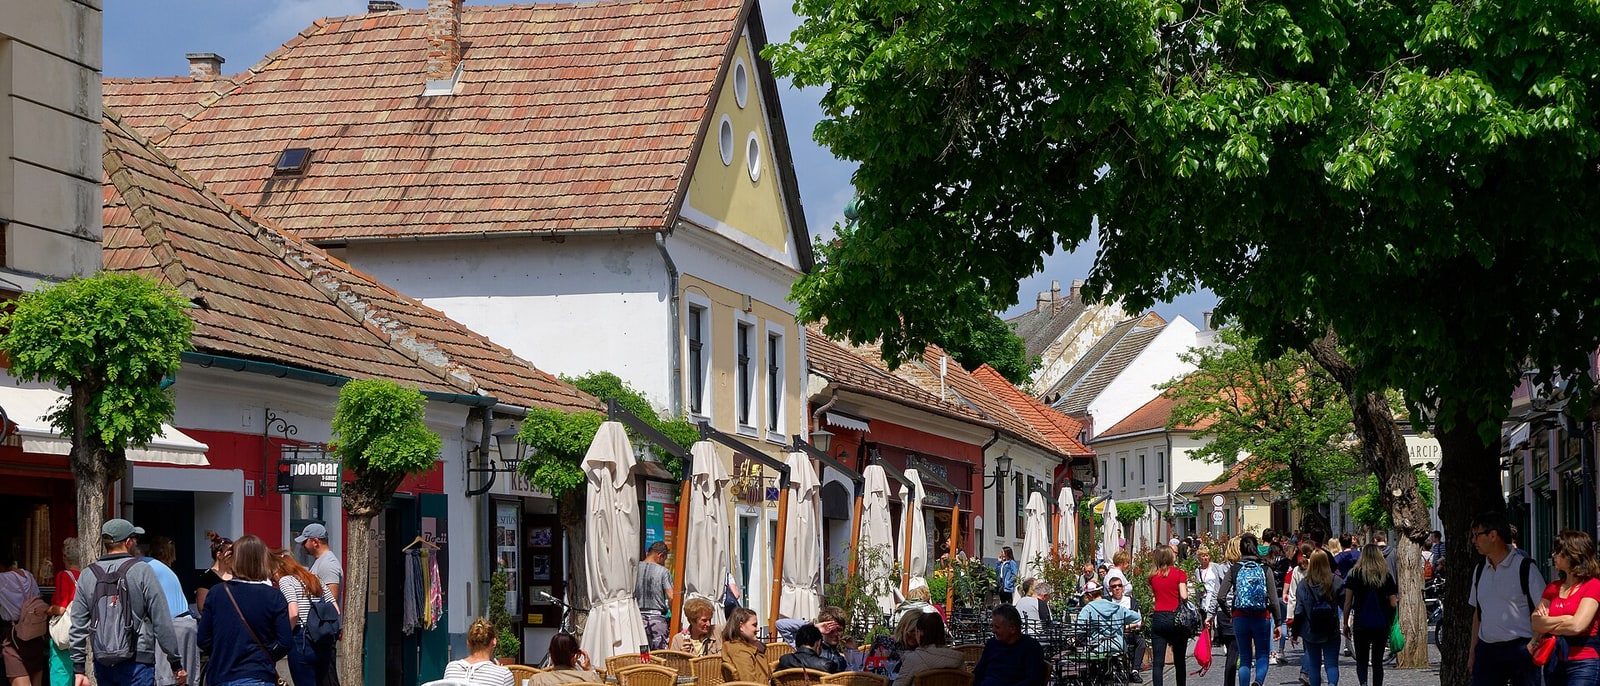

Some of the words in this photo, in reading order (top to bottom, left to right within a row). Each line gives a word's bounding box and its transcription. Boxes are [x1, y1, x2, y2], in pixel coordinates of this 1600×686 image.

[1409, 445, 1439, 458] ARCIP
[290, 462, 338, 477] polobar
[247, 485, 253, 496] 11
